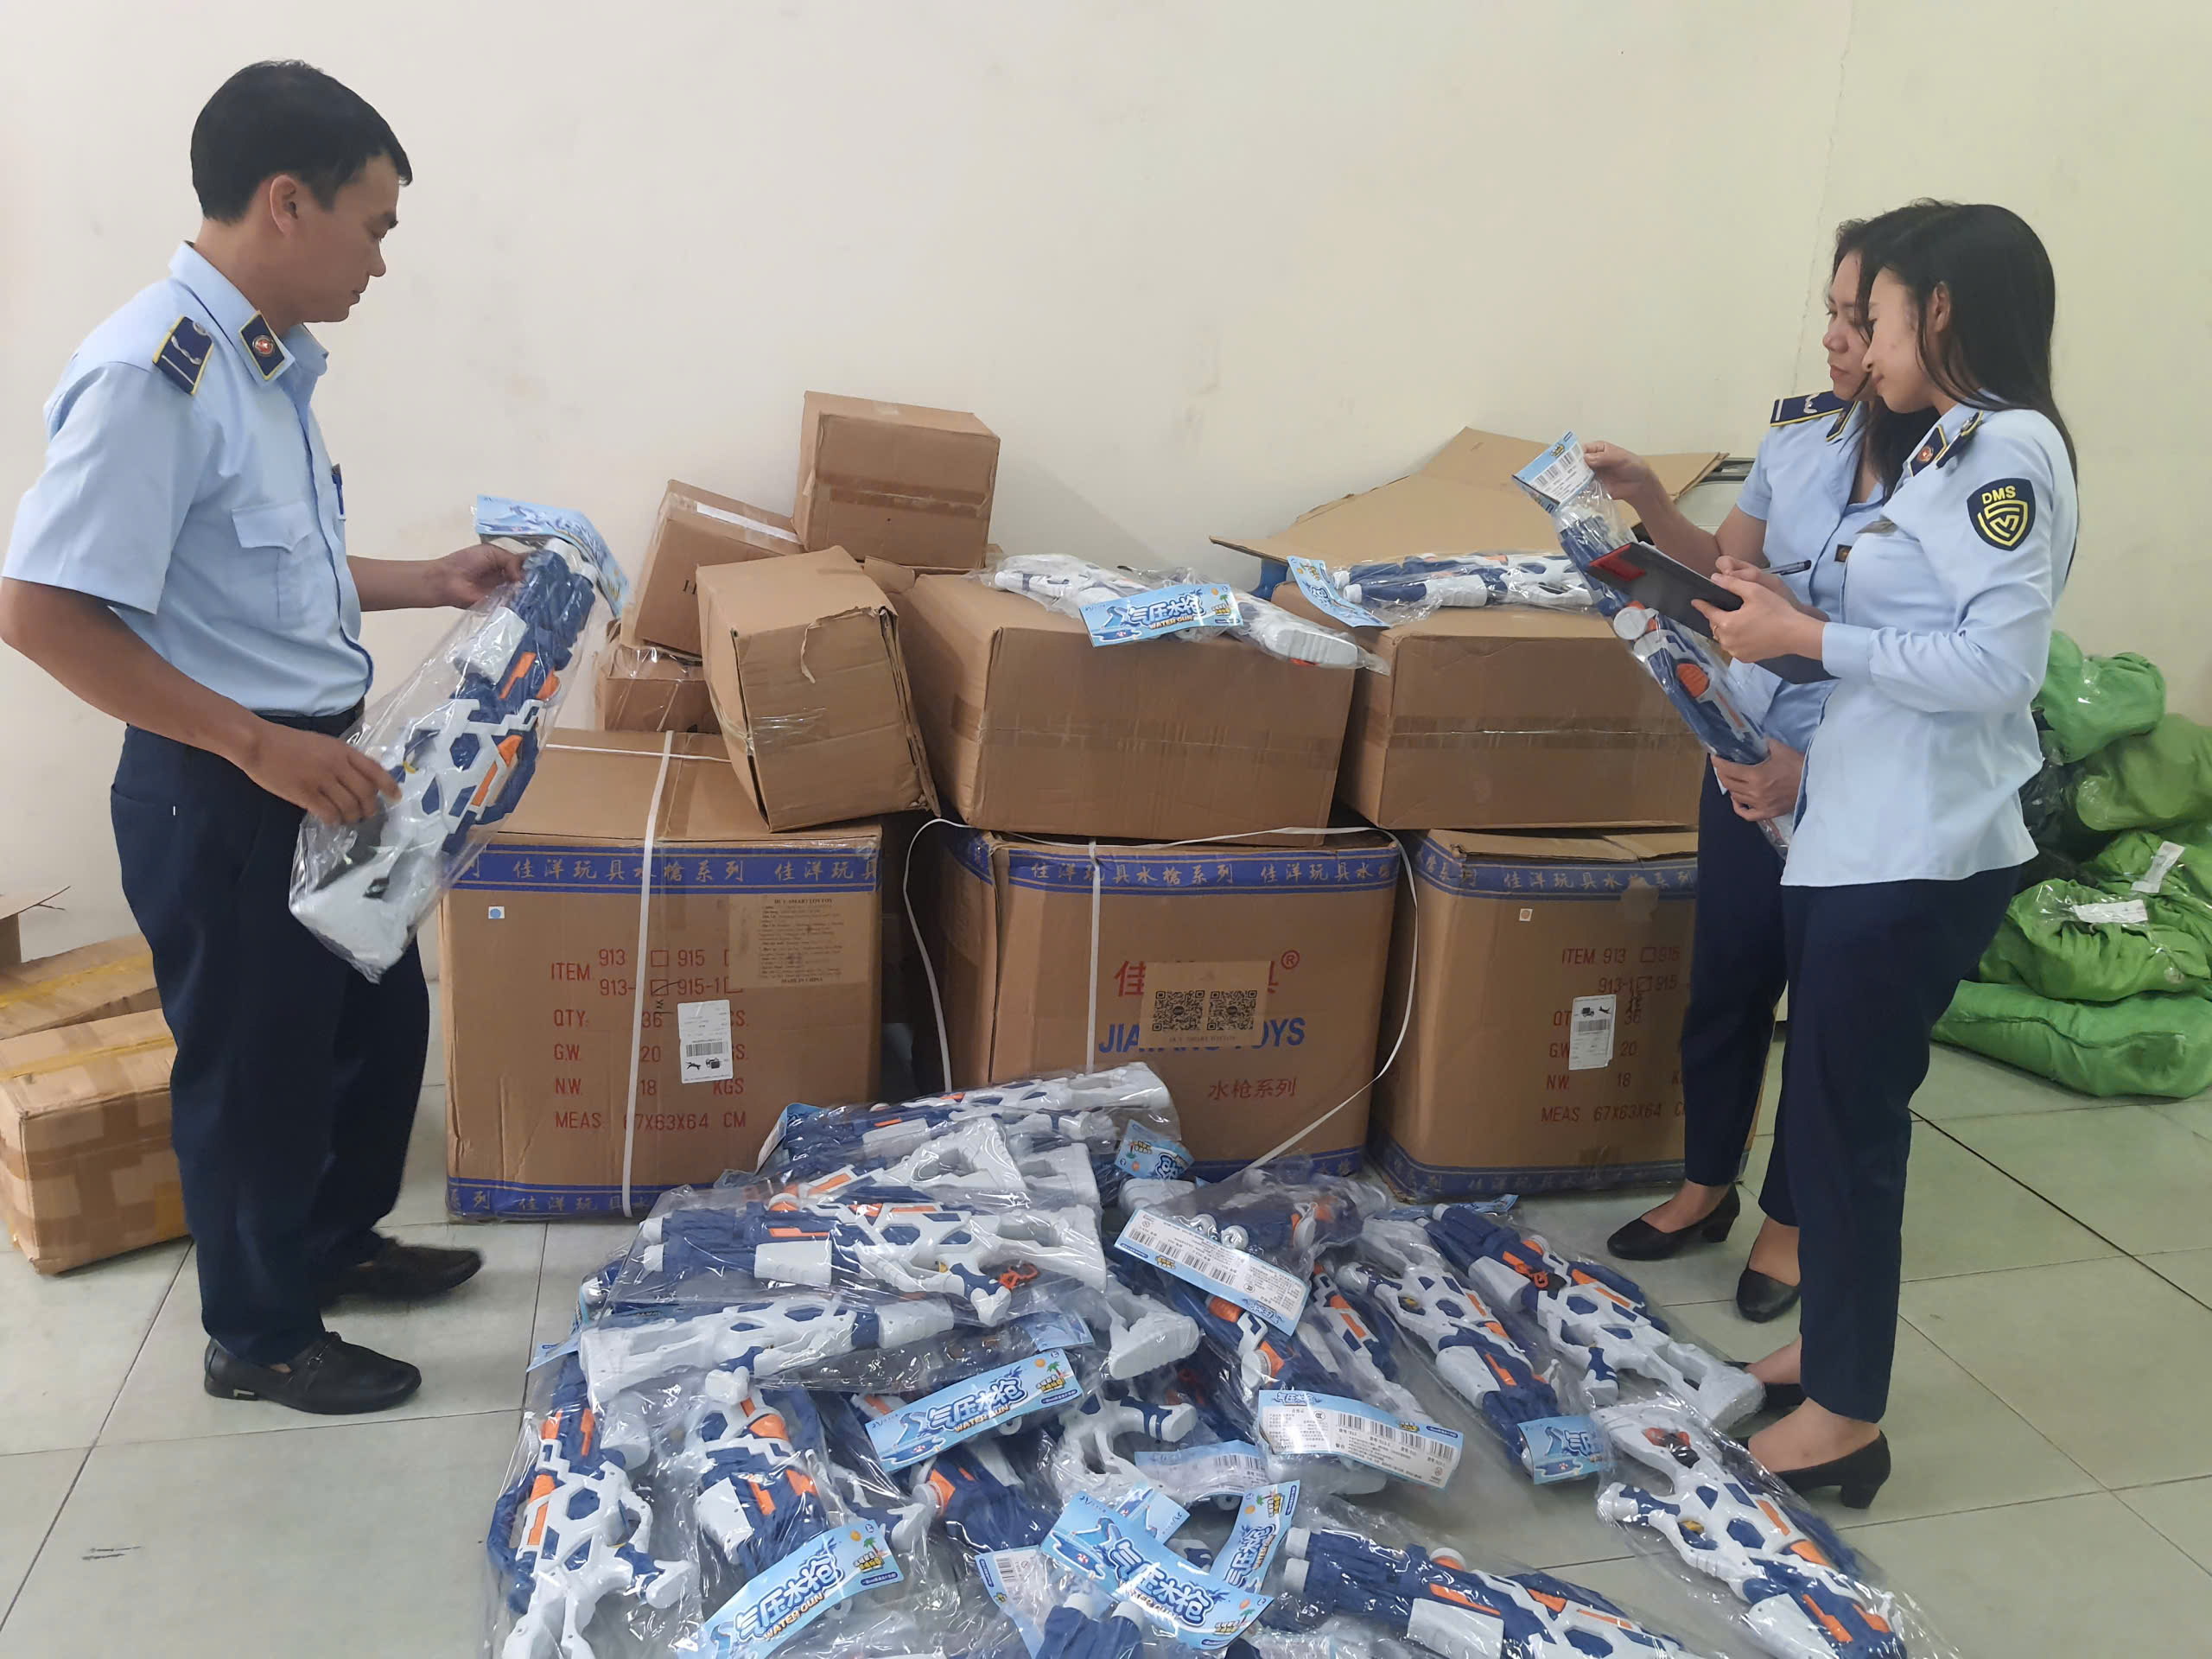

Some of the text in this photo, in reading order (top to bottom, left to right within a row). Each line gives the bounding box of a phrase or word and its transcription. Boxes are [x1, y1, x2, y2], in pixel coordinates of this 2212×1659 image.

[1981, 485, 2017, 505] DMS
[550, 948, 705, 982] ITEM 913 915
[1603, 947, 1626, 964] 913
[600, 977, 720, 996] 913- 915-1
[641, 1011, 663, 1028] 36
[639, 1045, 662, 1063] 20
[1620, 1040, 1637, 1057] 20
[640, 1079, 658, 1096] 18
[1209, 1077, 1297, 1101] 水枪系列
[1617, 1071, 1631, 1088] 18
[722, 1111, 747, 1128] CM
[927, 1376, 1028, 1431] 气压水枪
[954, 1413, 989, 1433] WATER
[735, 1553, 845, 1642] 气压水枪
[763, 1592, 825, 1641] WATER GUN
